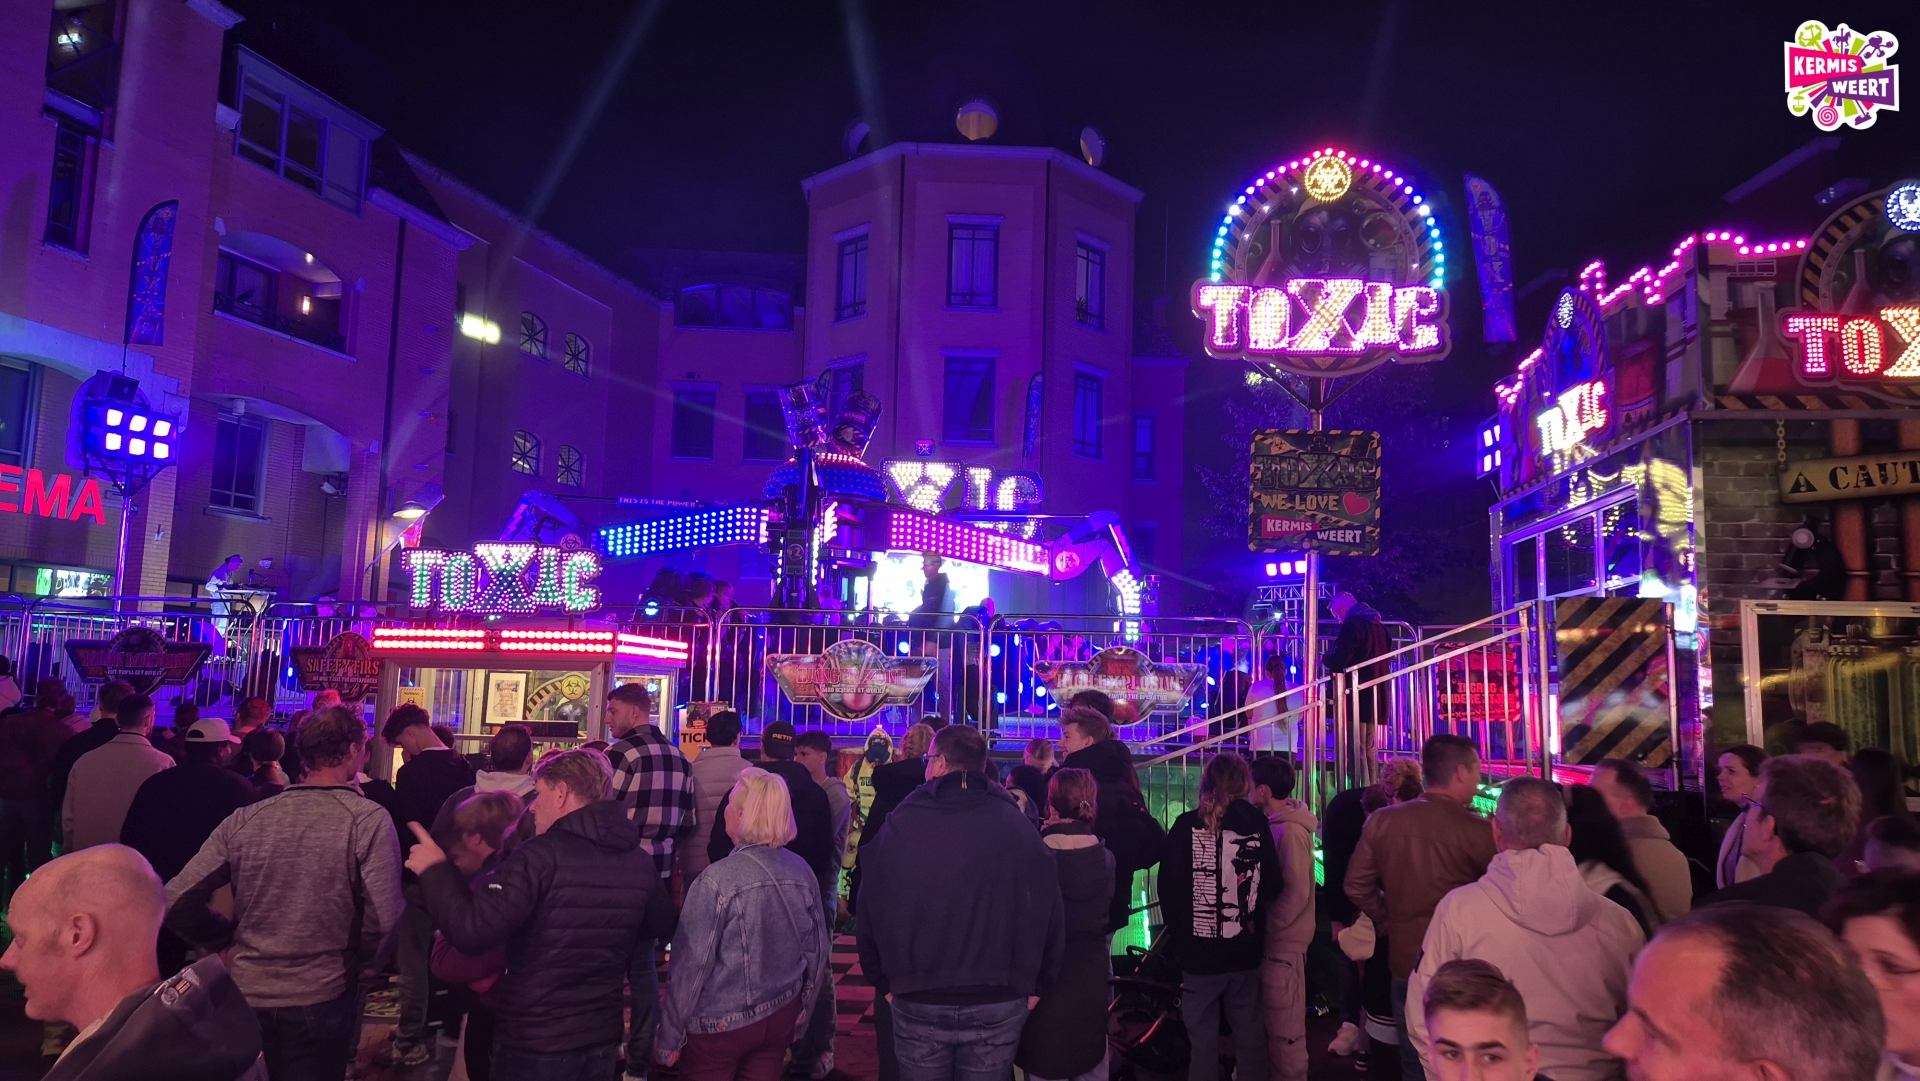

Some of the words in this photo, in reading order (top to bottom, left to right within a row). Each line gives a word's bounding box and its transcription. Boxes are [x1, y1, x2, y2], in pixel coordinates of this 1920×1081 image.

[1199, 278, 1440, 352] TOXIC
[1536, 381, 1607, 456] TOXIC
[1253, 451, 1376, 490] TOXIC
[667, 500, 696, 508] POWER
[1260, 493, 1289, 511] WE
[1295, 493, 1340, 512] LOVE
[1266, 518, 1313, 532] KERMIS
[1316, 529, 1362, 543] WEERT
[401, 543, 599, 614] TOXIC
[306, 658, 352, 674] SAFETY
[353, 660, 380, 676] FIRS
[796, 667, 860, 685] DANGER
[862, 669, 907, 686] ZONE
[1097, 674, 1184, 691] EXPLOSIVE
[1457, 682, 1497, 693] IGAG
[771, 733, 793, 742] PETIT
[1192, 871, 1218, 938] HOLLYWOOD
